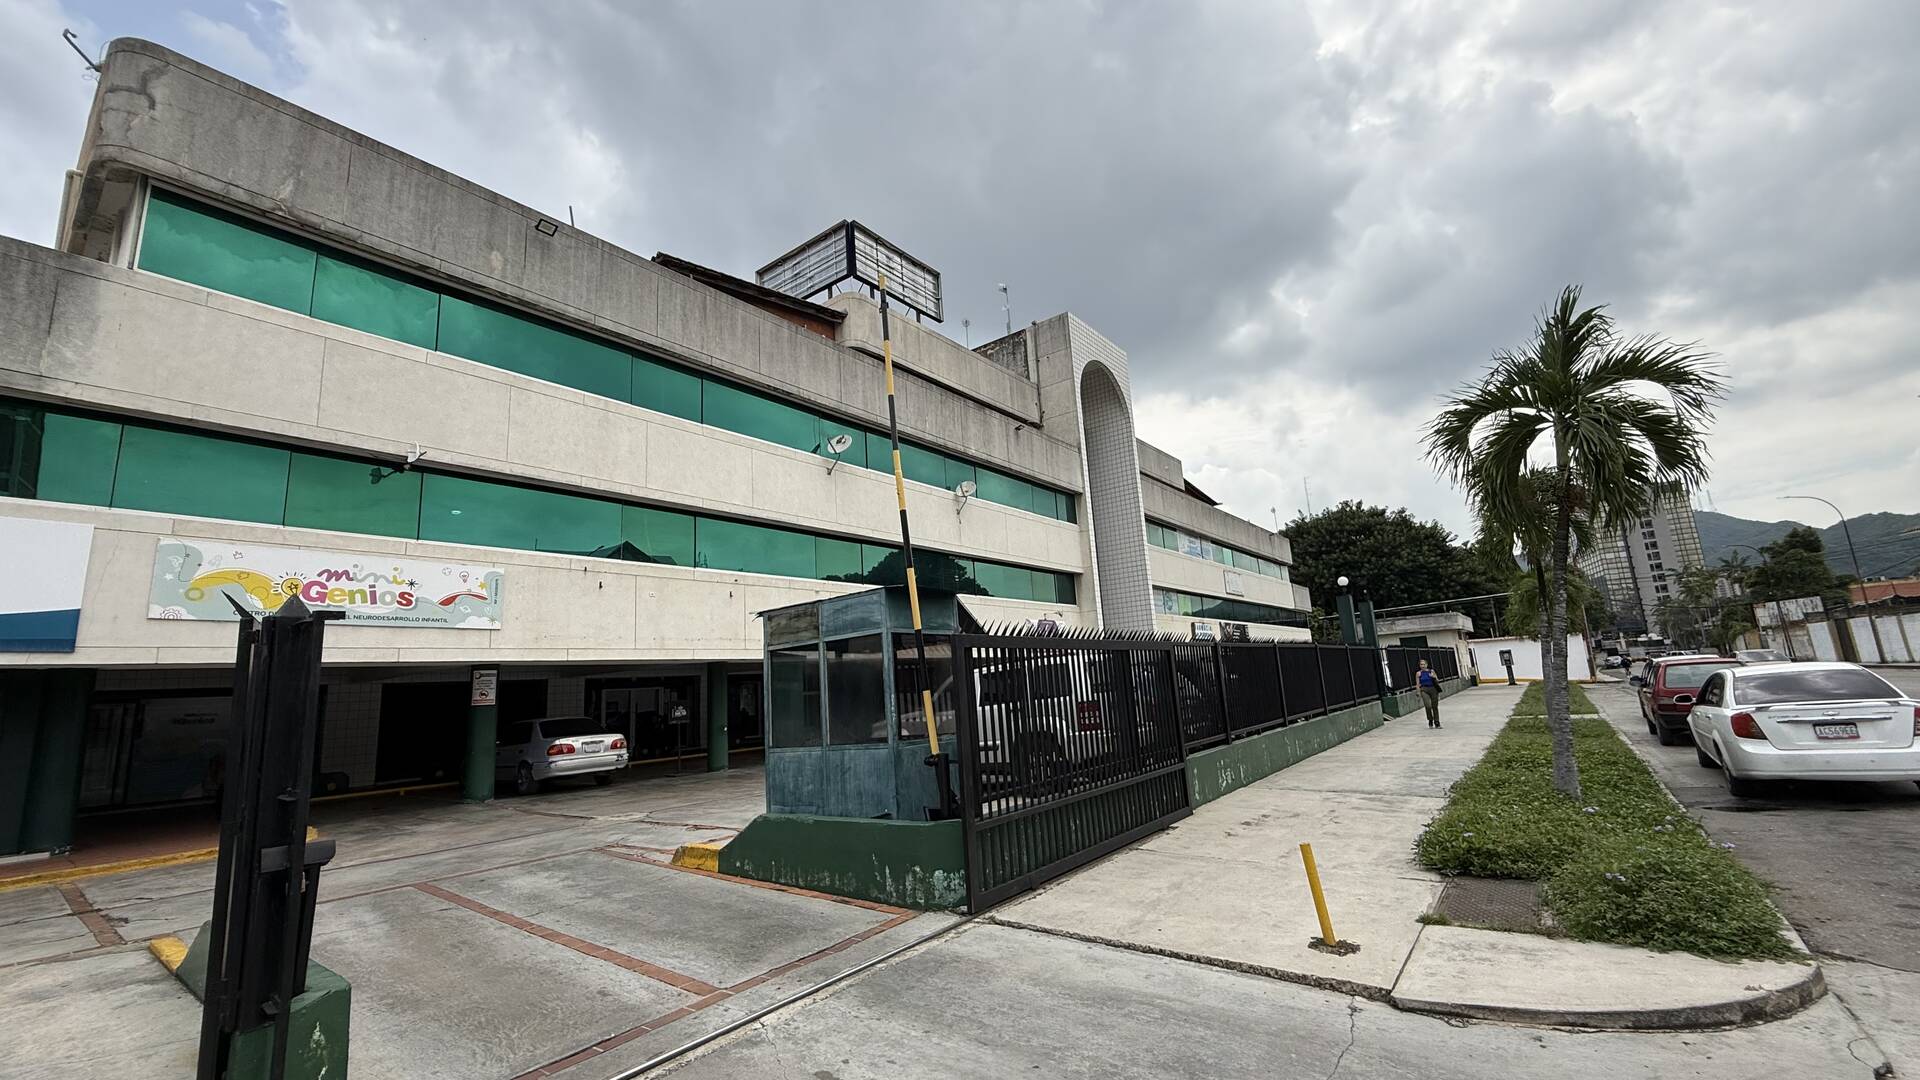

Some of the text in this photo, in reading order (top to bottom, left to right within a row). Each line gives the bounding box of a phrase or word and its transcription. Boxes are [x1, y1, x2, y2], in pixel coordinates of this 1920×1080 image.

[317, 564, 406, 586] mini
[301, 580, 415, 607] Genios
[353, 614, 420, 623] NEURODESARROLLO
[421, 616, 448, 624] INFANTIL
